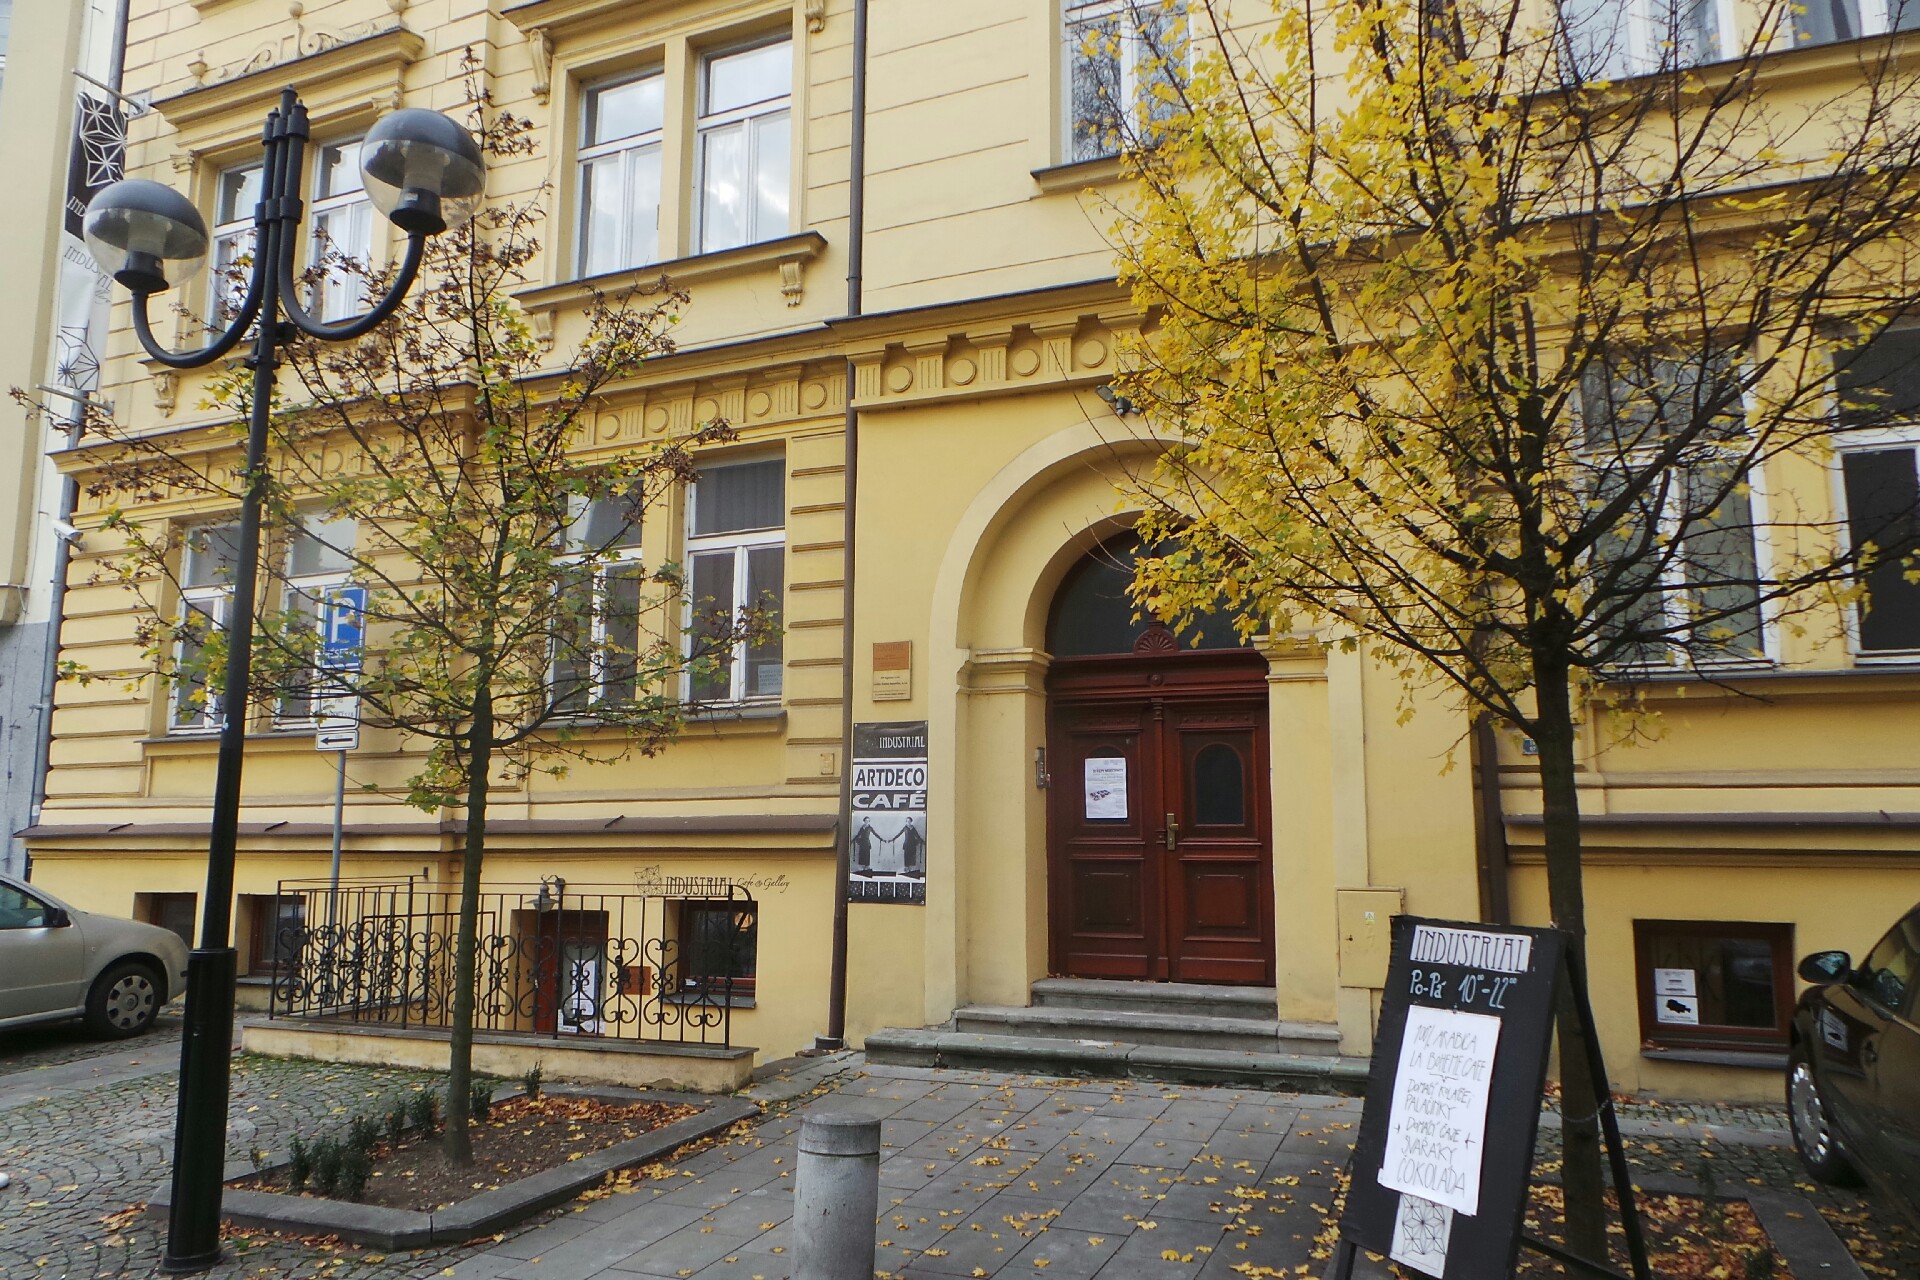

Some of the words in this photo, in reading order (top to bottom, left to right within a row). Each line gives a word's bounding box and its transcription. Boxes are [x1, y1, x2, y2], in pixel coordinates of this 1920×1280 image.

[331, 597, 356, 643] P
[879, 736, 926, 749] INDUSTRIAL
[855, 767, 925, 787] ARTDECO
[852, 790, 926, 809] CAFÉ
[665, 876, 734, 896] INDUSTRIAL
[1414, 930, 1526, 973] INDUSTRIAL
[1410, 1050, 1422, 1068] LA
